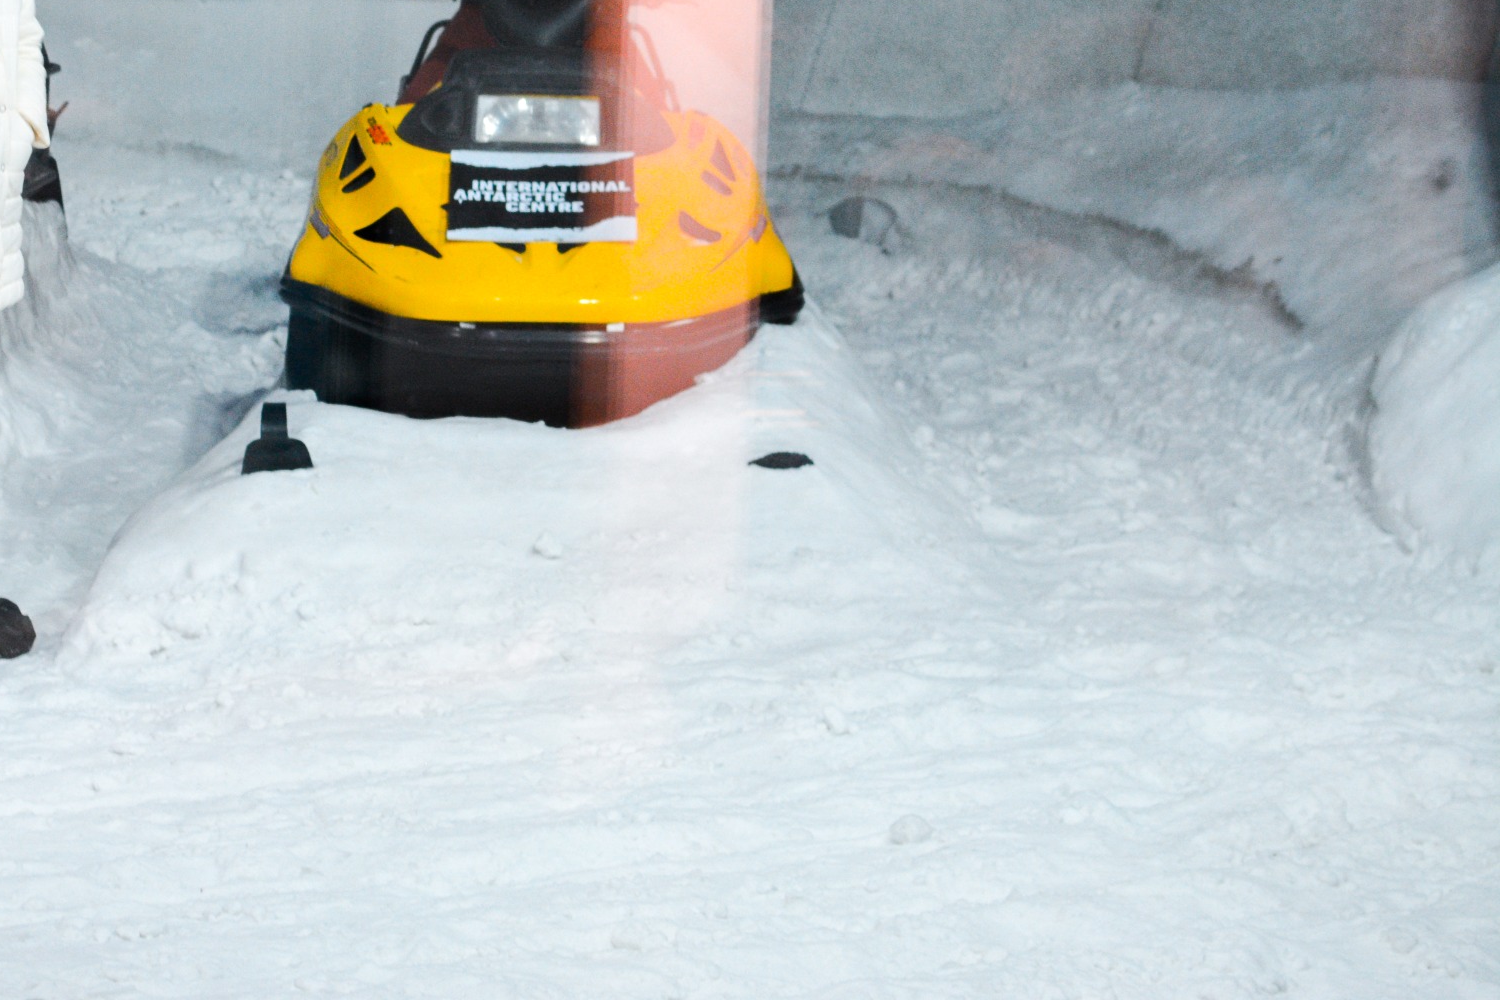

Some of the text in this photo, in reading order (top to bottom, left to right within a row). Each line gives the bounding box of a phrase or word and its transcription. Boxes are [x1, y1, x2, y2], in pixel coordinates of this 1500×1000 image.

[472, 179, 631, 193] INTERNATIONAL
[454, 189, 565, 204] ANTARCTIC
[505, 201, 584, 213] CENTRE
